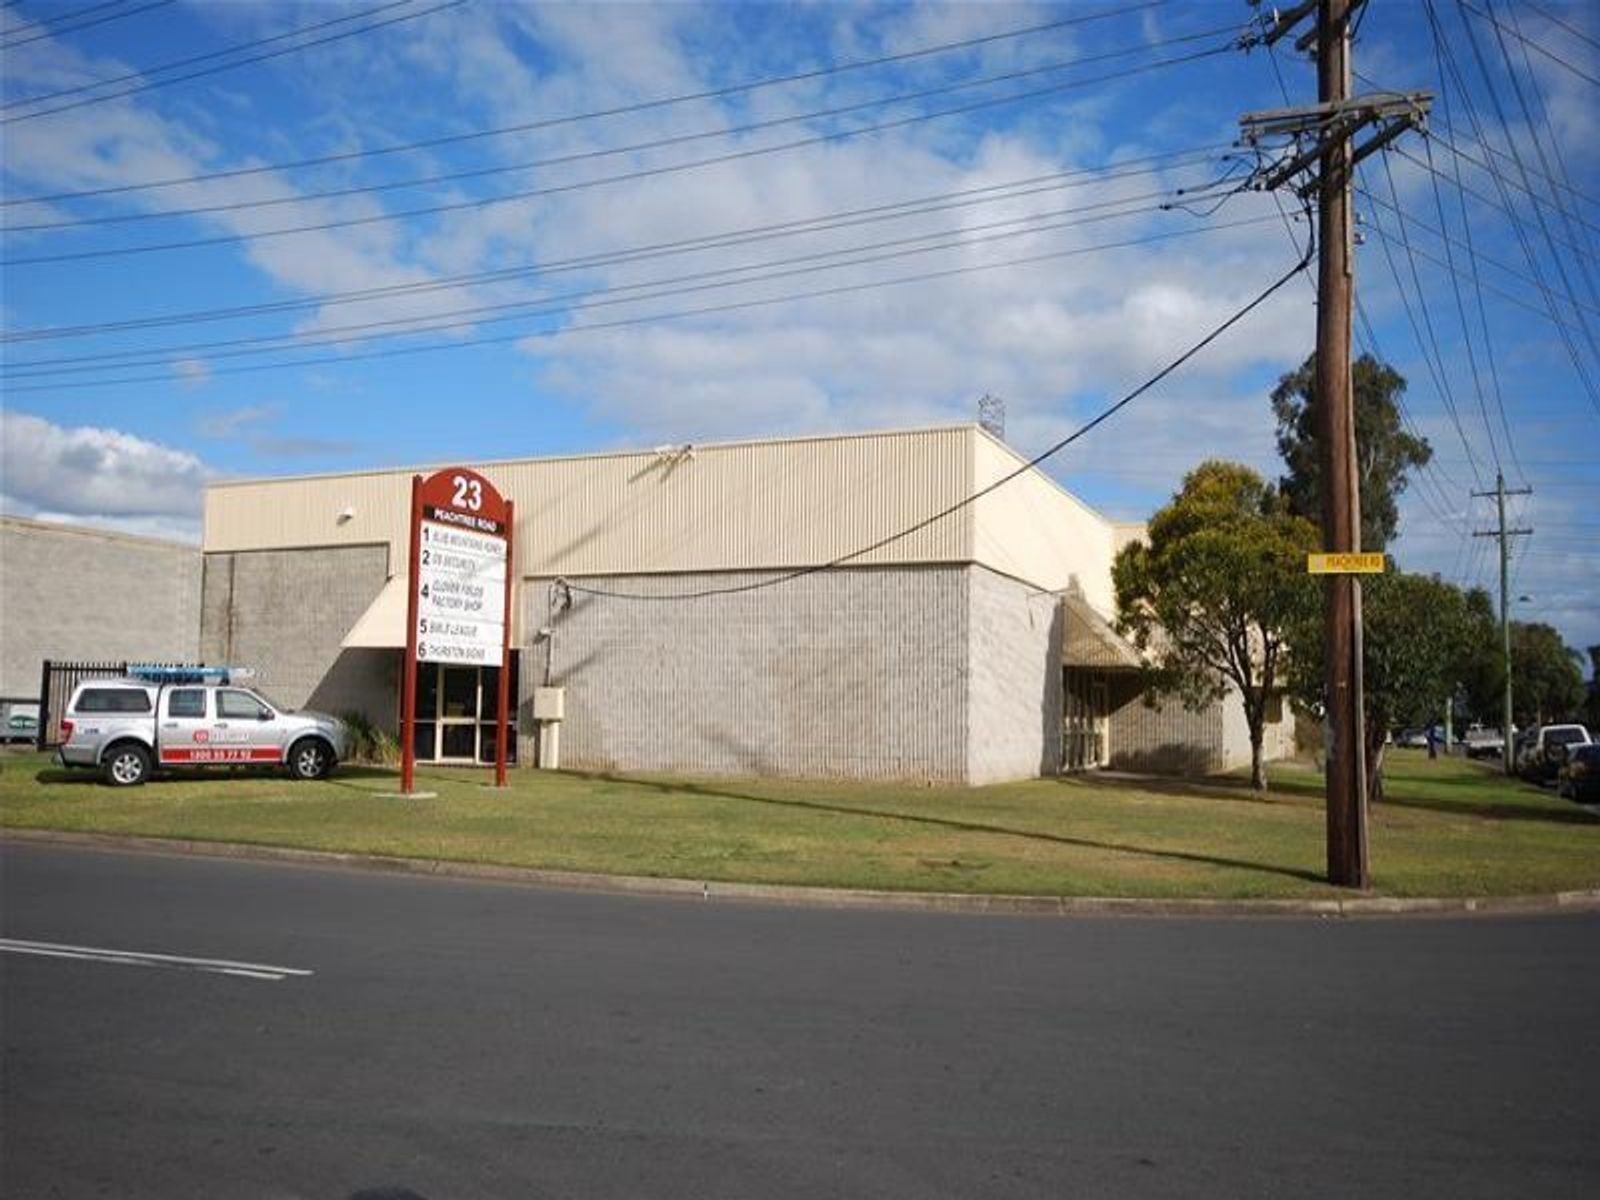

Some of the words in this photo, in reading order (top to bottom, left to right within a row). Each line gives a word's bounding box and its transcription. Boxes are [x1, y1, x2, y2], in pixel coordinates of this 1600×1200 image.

[452, 476, 482, 511] 23
[434, 507, 475, 528] PEACHTREE
[477, 517, 497, 533] ROAD
[423, 527, 430, 541] 1
[422, 549, 430, 565] 2
[1326, 555, 1368, 568] PEACHTREE
[420, 583, 429, 599] 4
[420, 618, 427, 634] 5
[418, 641, 427, 658] 6
